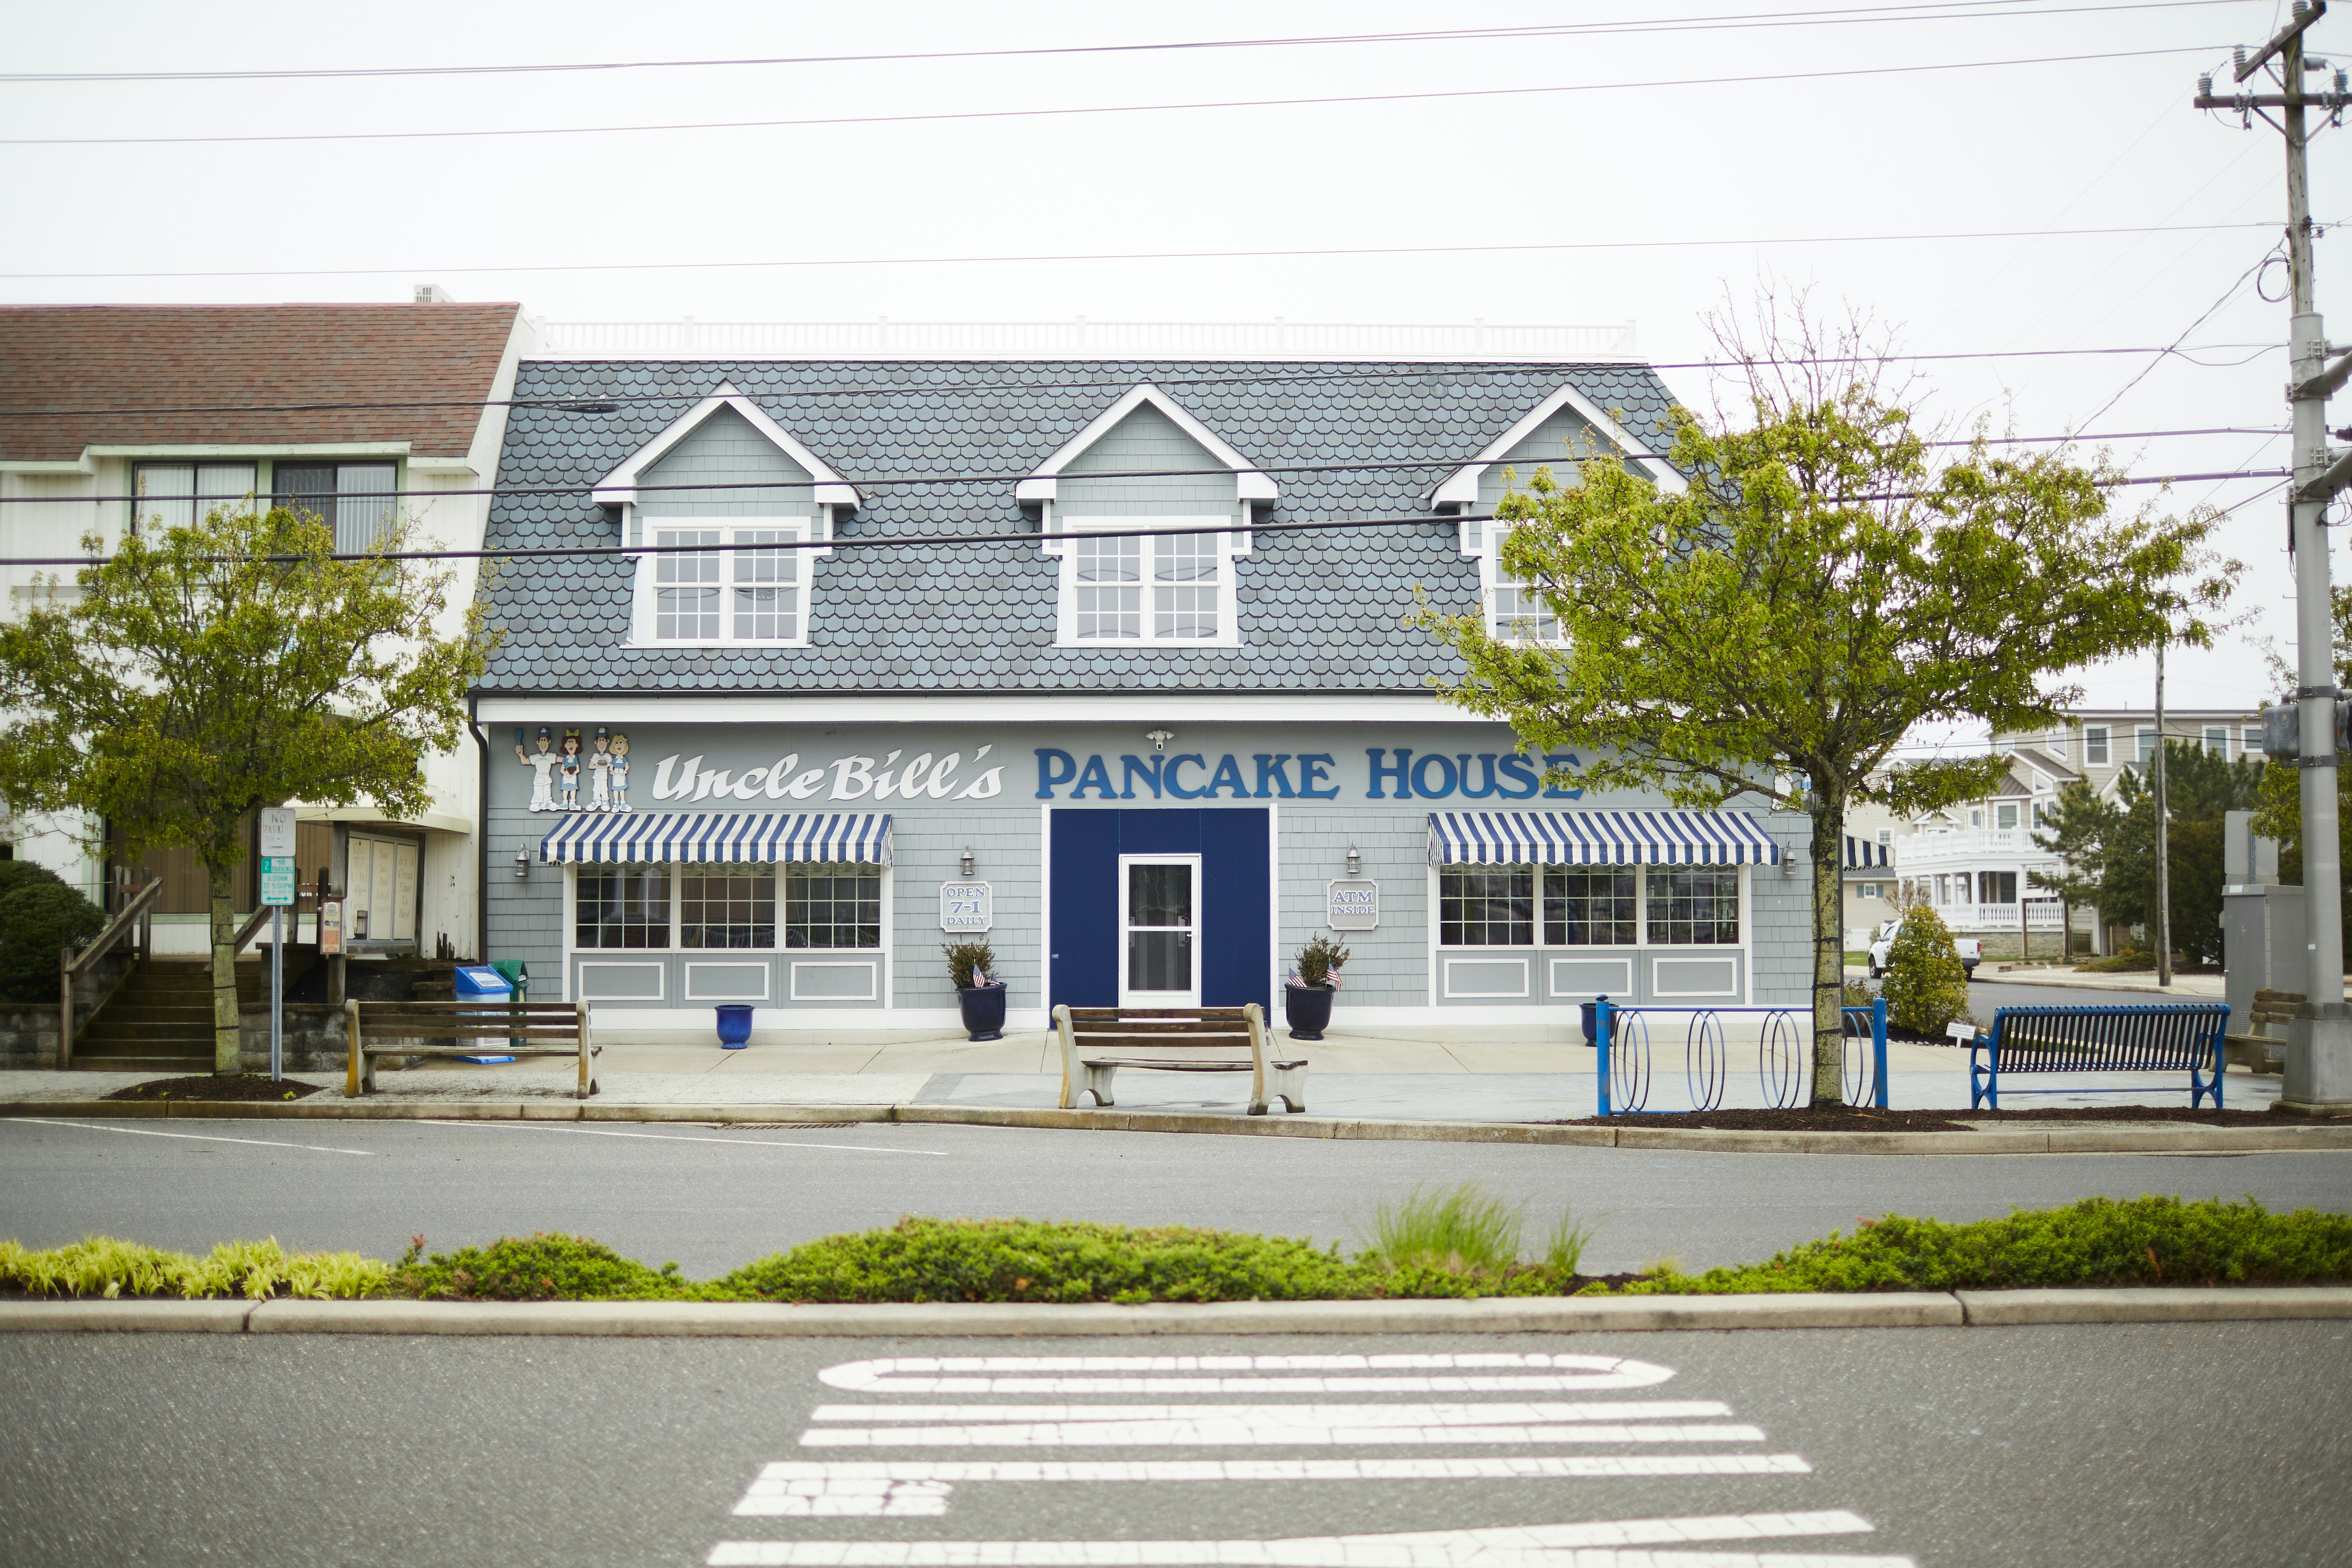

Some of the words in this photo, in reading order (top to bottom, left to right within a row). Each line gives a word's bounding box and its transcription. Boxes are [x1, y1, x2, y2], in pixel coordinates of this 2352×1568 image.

[652, 753, 826, 803] Uncle
[826, 744, 1007, 801] Bill's
[1034, 748, 1340, 800] PANCAKE
[1366, 748, 1584, 800] HOUSE
[272, 814, 286, 823] NO
[265, 861, 269, 870] 2
[399, 855, 407, 866] It's
[410, 858, 414, 867] A
[398, 869, 413, 880] Great
[399, 881, 412, 893] Time
[946, 887, 986, 897] OPEN
[402, 895, 408, 906] To
[1332, 890, 1373, 903] ATM
[950, 900, 981, 914] 7-1
[1331, 906, 1375, 915] INSIDE
[946, 916, 986, 925] DAILY
[705, 1353, 1918, 1568] ONLY
